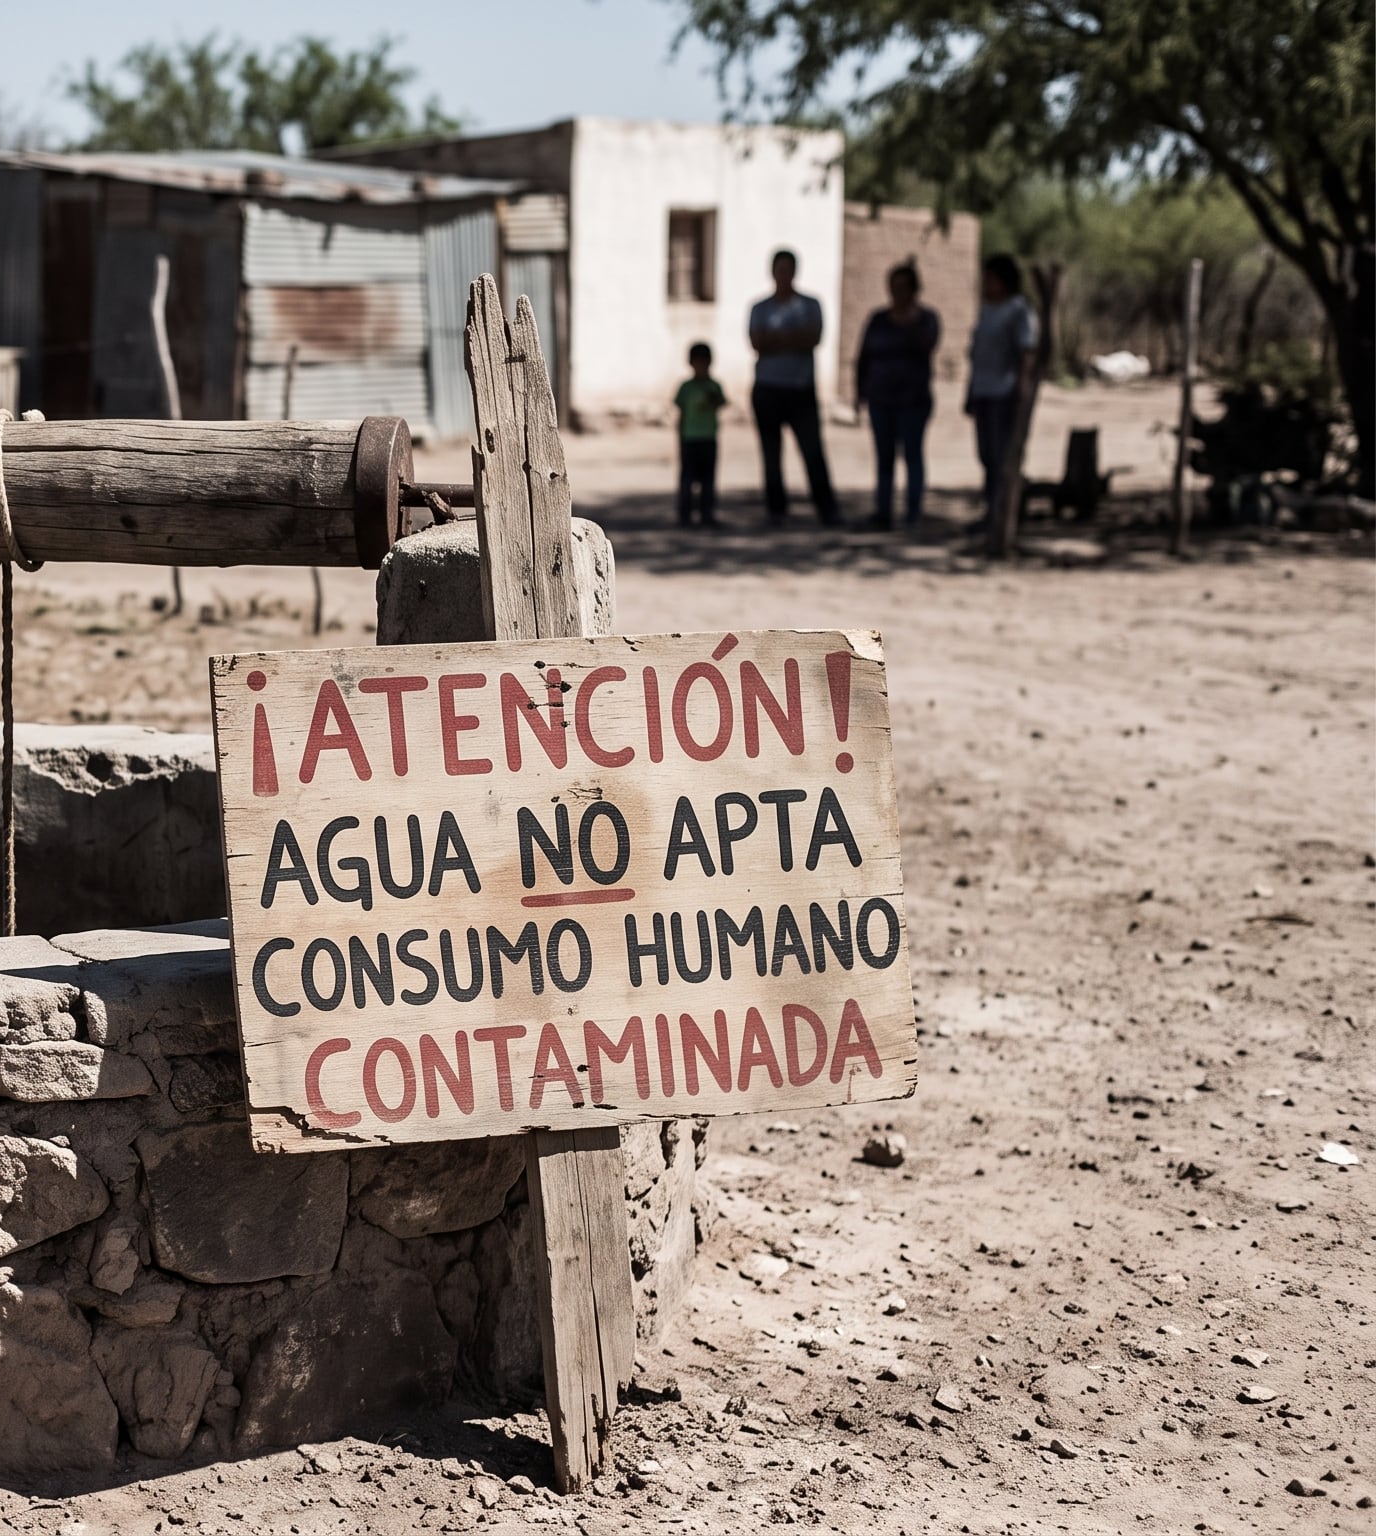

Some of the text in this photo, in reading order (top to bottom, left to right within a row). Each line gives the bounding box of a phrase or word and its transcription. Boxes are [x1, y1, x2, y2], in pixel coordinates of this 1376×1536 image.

[246, 632, 854, 797] ¡ATENCIÓN!
[261, 787, 863, 911] AGUA NO APTA
[252, 897, 900, 1017] CONSUMO HUMANO
[305, 999, 883, 1129] CONTAMINADA
